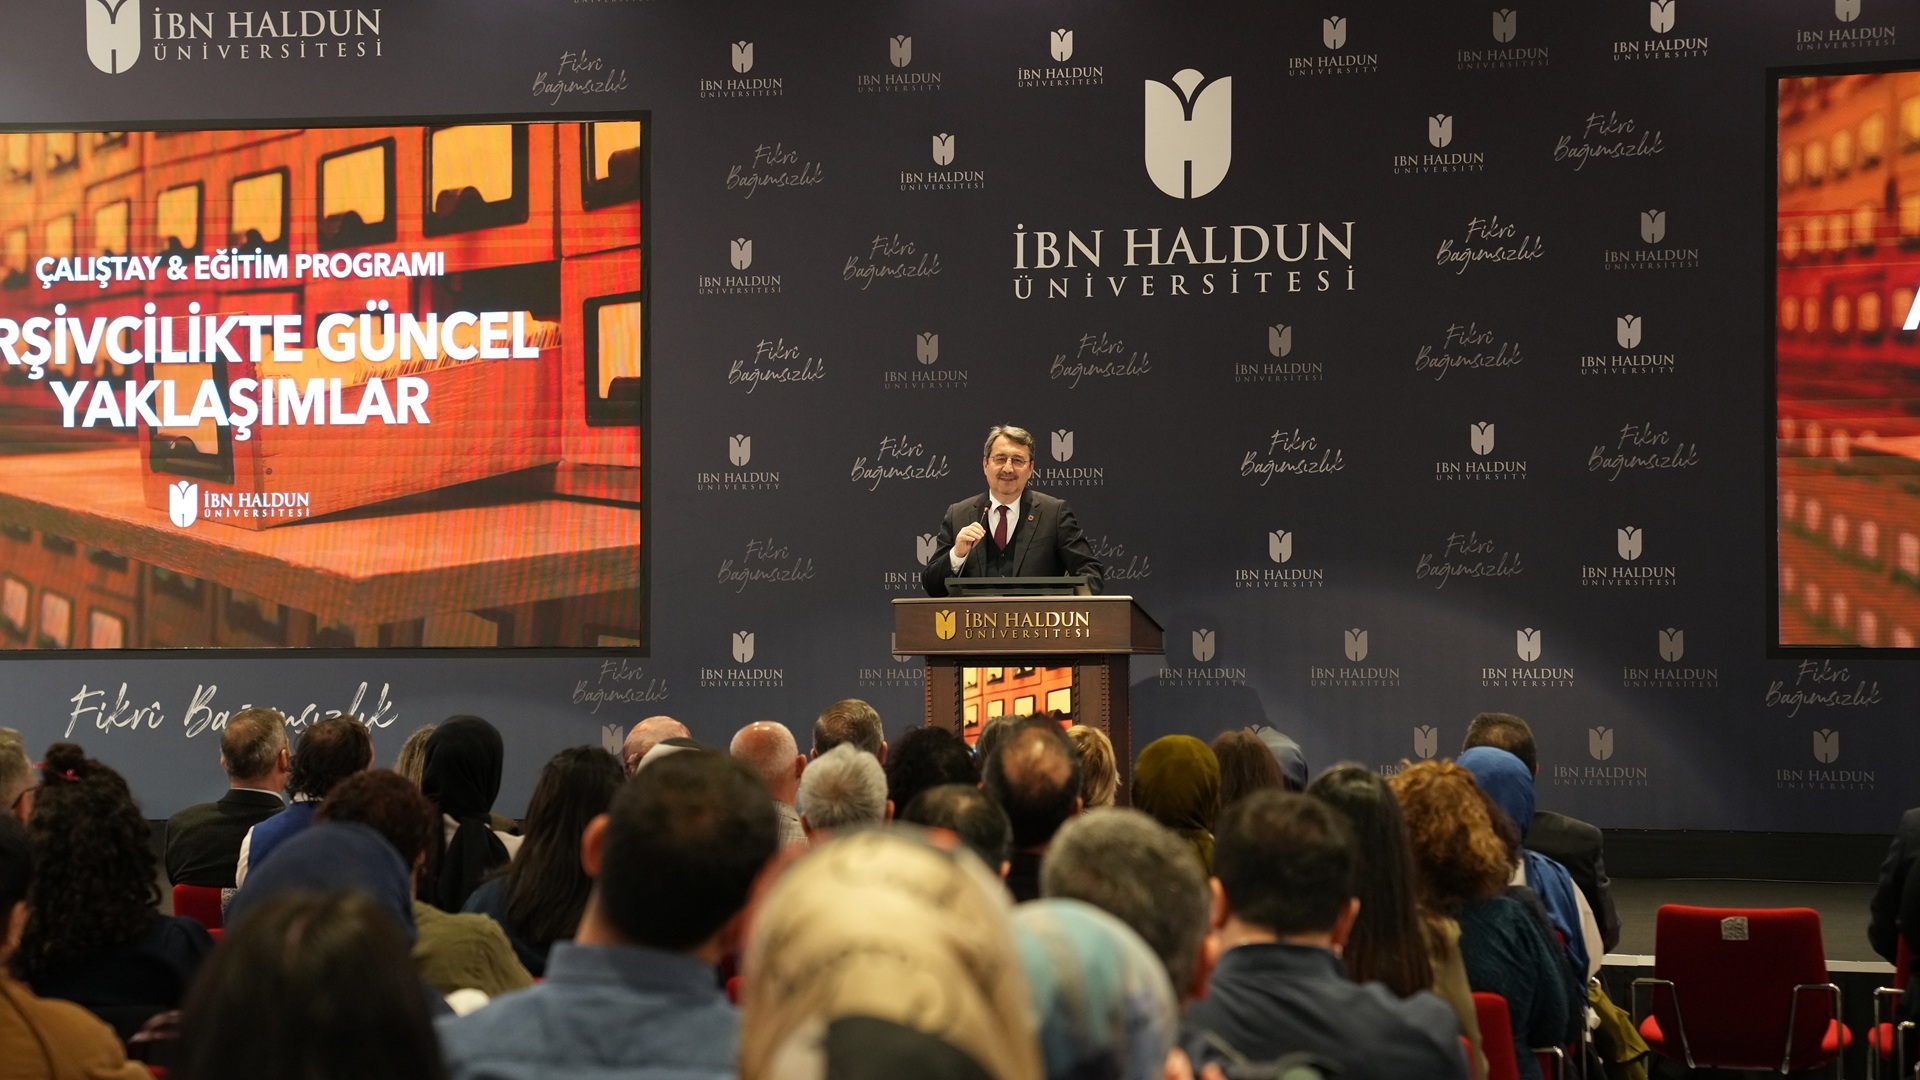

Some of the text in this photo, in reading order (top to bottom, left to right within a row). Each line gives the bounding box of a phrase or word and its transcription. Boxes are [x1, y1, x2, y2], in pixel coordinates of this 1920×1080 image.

[153, 7, 381, 39] İBN HALDUN
[1797, 26, 1895, 43] İBN HALDUN
[154, 38, 381, 61] ÜNİVERSİTESİ
[1614, 37, 1708, 53] IBN HALDUN
[1290, 54, 1377, 68] IBN HALDUN
[1458, 47, 1548, 62] İBN HALDUN
[1614, 50, 1708, 61] UNIVERSITY
[1018, 67, 1103, 80] İBN HALDUN
[1289, 66, 1377, 76] UNIVERSITY
[701, 78, 782, 90] İBN HALDUN
[858, 72, 941, 85] IBN HALDUN
[858, 84, 941, 93] UNIVERSITY
[1394, 153, 1483, 166] IBN HALDUN
[1394, 165, 1484, 174] UNIVERSITY
[901, 171, 984, 183] İBN HALDUN
[1013, 222, 1355, 270] İBN HALDUN
[1605, 249, 1698, 262] İBN HALDUN
[35, 248, 444, 289] ÇALIŞTAY & EĞİTİM PROGRAMI
[700, 275, 780, 287] İBN HALDUN
[1014, 265, 1354, 299] ÜNİVERSİTESİ
[316, 300, 539, 364] GÜNCEL
[1582, 354, 1674, 367] IBN HALDUN
[1236, 362, 1322, 375] İBN HALDUN
[1581, 367, 1674, 375] UNIVERSITY
[885, 370, 967, 382] IBN HALDUN
[50, 376, 430, 441] YAKLAŞIMLAR
[1047, 468, 1103, 478] HALDUN
[1437, 461, 1526, 473] IBN HALDUN
[698, 472, 779, 483] IBN HALDUN
[1436, 473, 1526, 481] UNIVERSITY
[204, 490, 309, 508] İBN HALDUN
[885, 572, 907, 582] IBN
[1236, 569, 1322, 580] IBN HALDUN
[1583, 565, 1675, 578] İBN HALDUN
[965, 609, 1089, 627] İBN HALDUN
[701, 667, 783, 679] İBN HALDUN
[860, 669, 926, 679] IBN HALD
[1159, 667, 1245, 679] IBN HALDUN
[1311, 666, 1399, 678] İBN HALDUN
[1483, 668, 1573, 679] IBN HALDUN
[1624, 666, 1717, 679] İBN HALDUN
[1554, 764, 1647, 778] İBN HALDUN
[1777, 769, 1874, 782] IBN HALDUN
[1777, 782, 1874, 790] UNIVERSITY
